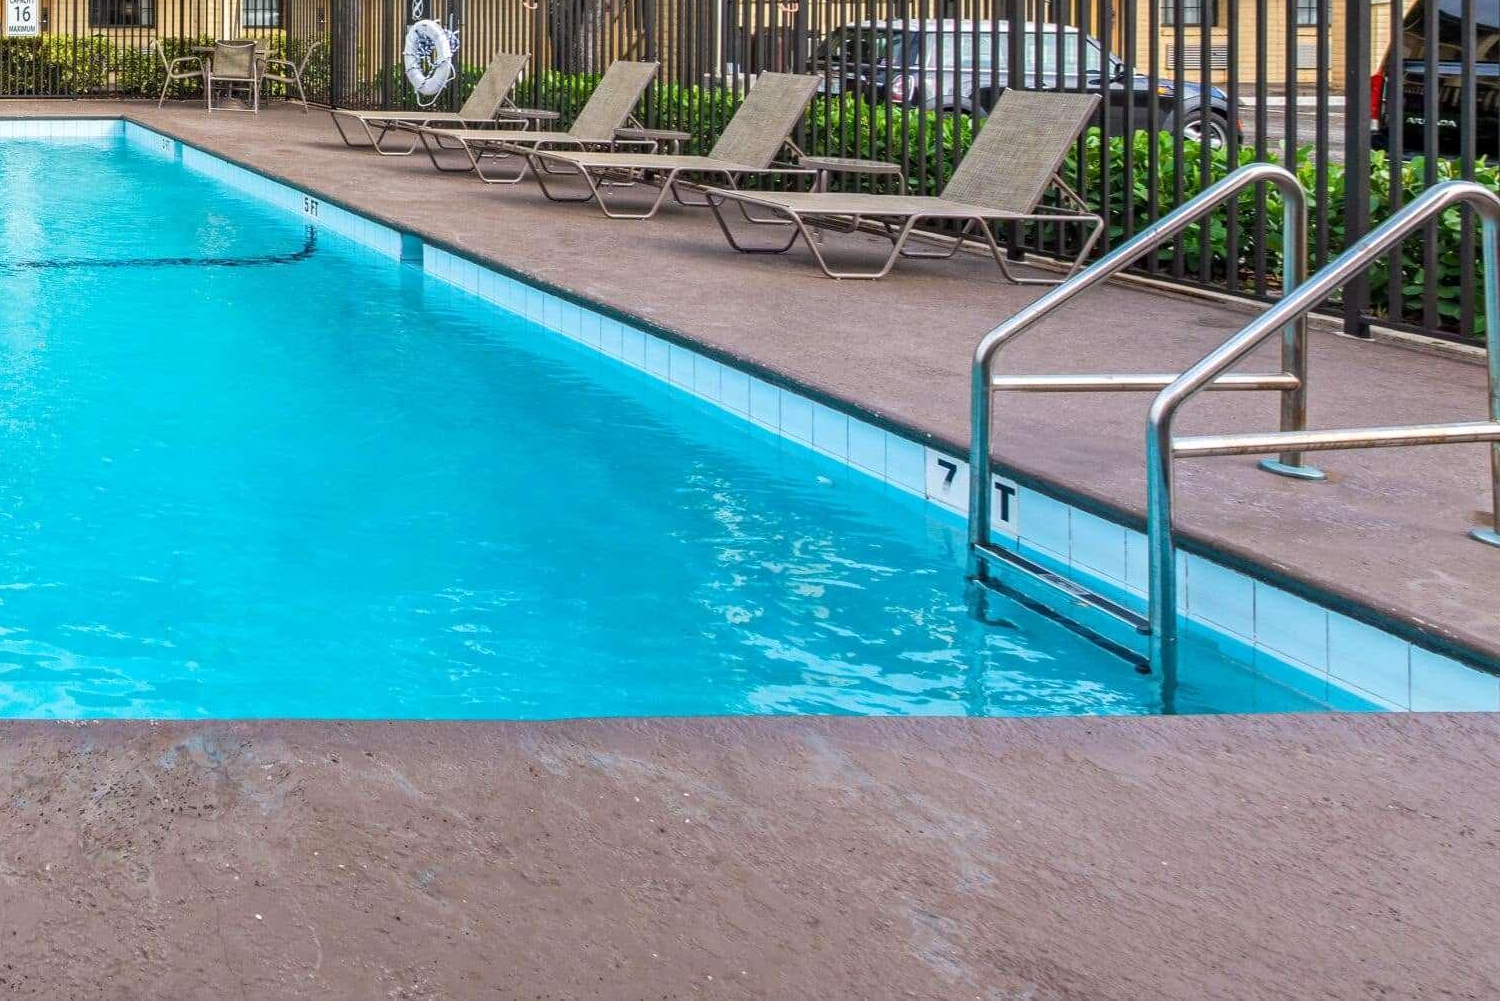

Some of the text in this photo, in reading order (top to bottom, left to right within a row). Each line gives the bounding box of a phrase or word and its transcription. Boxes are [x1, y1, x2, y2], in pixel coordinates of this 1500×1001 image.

[15, 6, 31, 21] 16
[304, 197, 319, 216] 5 FT
[937, 458, 1016, 522] 7 T
